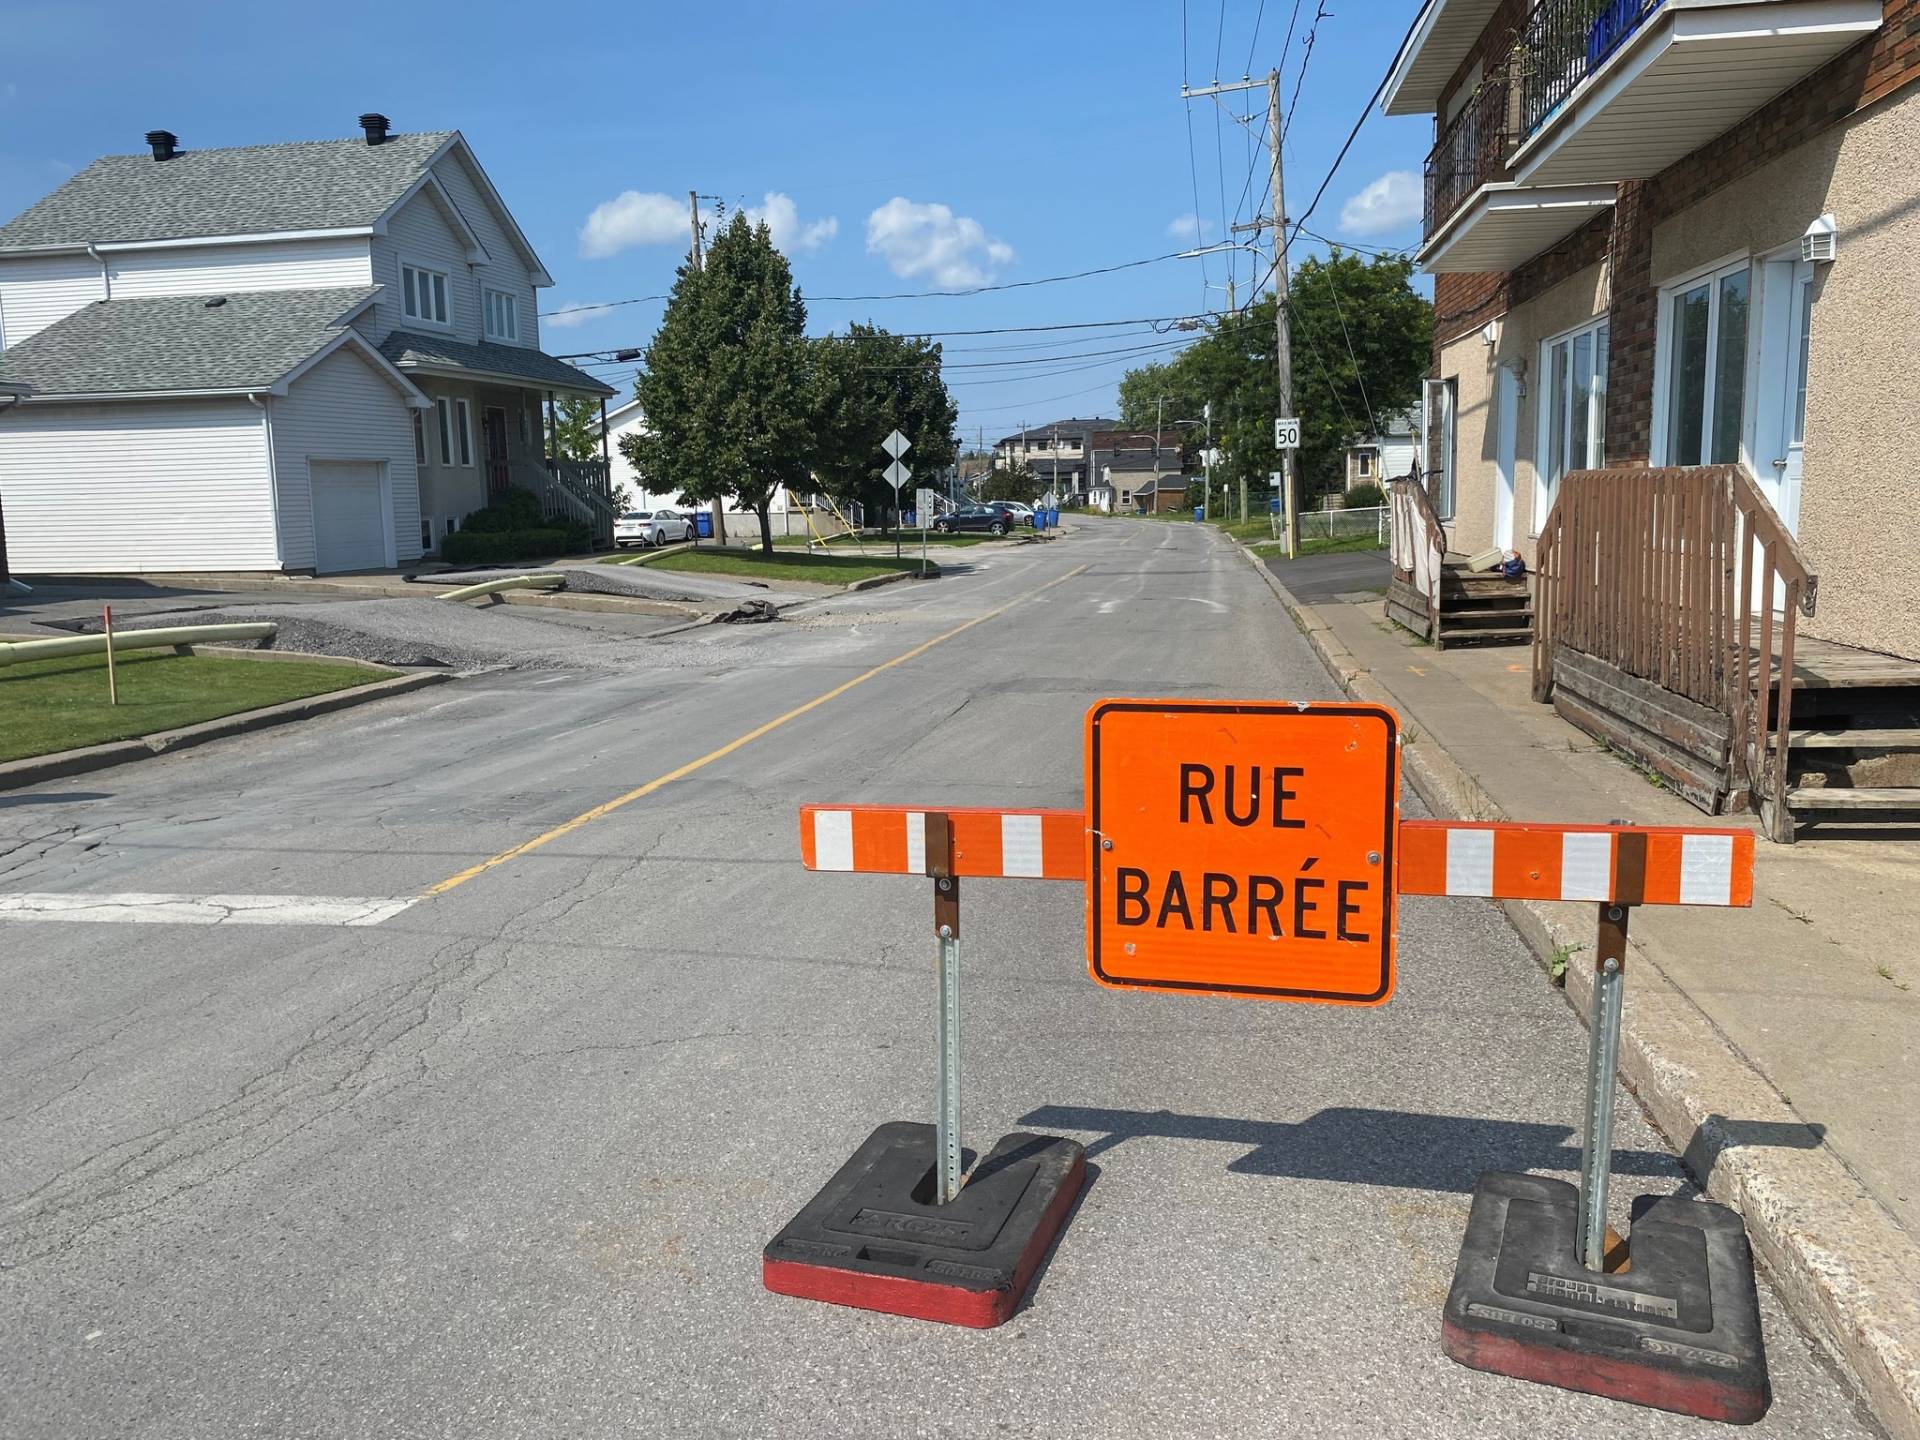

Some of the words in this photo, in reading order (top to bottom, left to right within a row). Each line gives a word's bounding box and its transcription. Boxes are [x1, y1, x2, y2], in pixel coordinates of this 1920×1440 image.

[1279, 428, 1297, 444] 50
[1180, 763, 1306, 829] RUE
[1117, 857, 1370, 943] BARRÉE
[1647, 1341, 1679, 1355] KG
